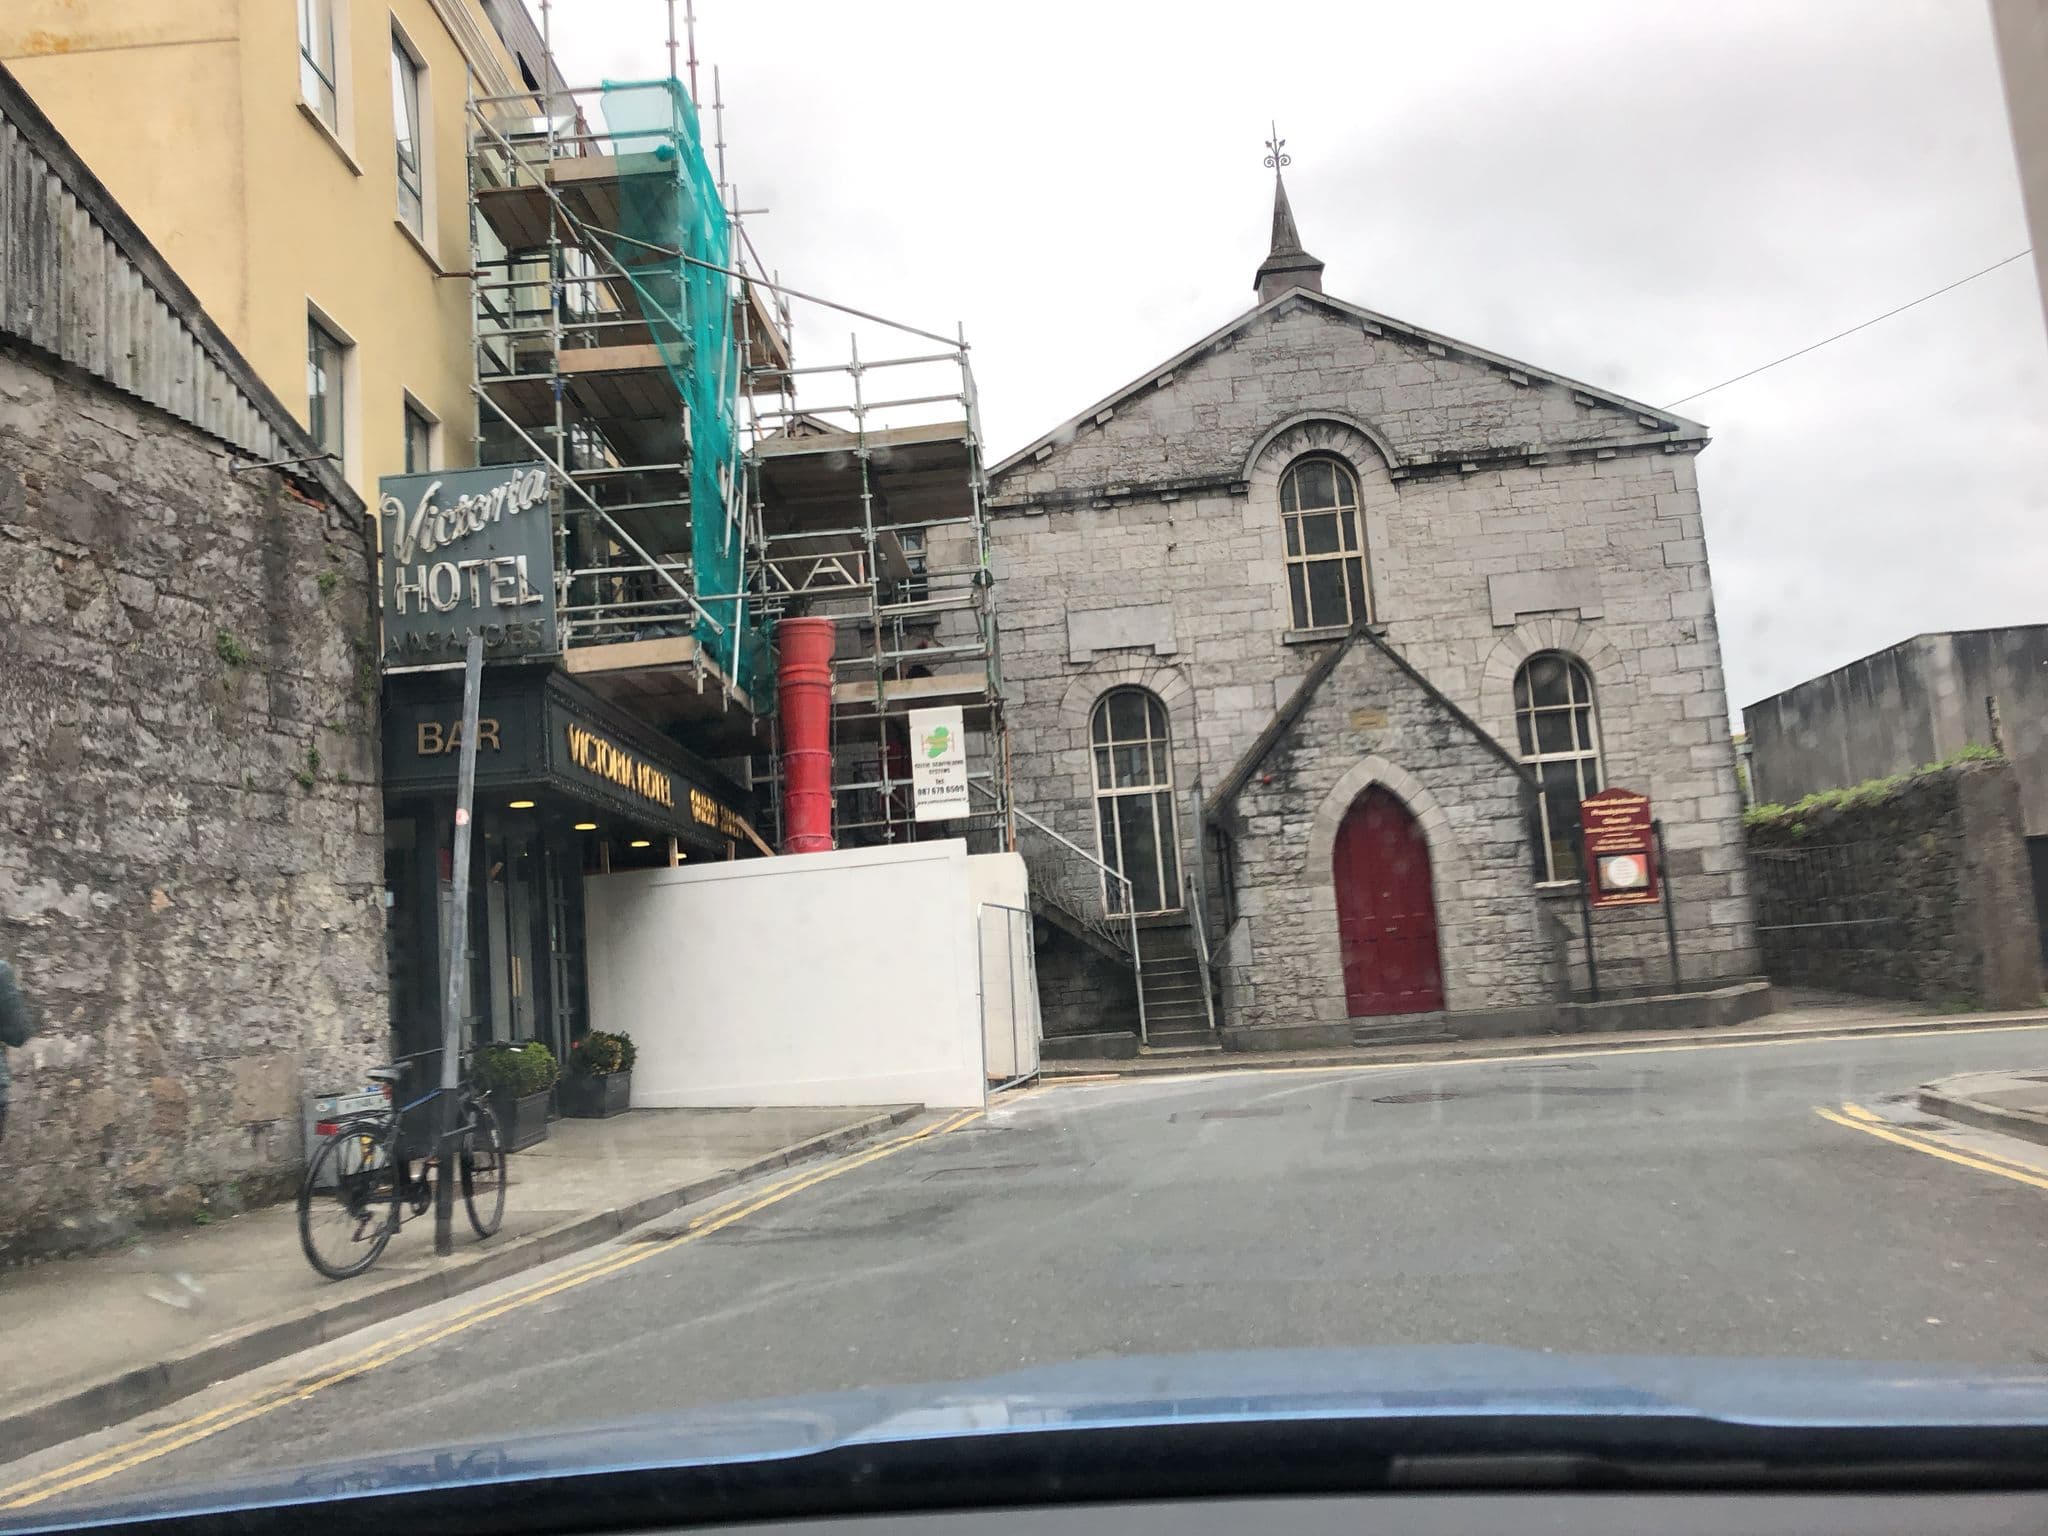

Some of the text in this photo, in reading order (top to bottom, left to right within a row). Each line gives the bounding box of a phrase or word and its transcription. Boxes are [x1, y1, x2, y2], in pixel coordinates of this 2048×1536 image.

[379, 468, 550, 565] Victoria
[395, 555, 544, 615] HOTEL
[417, 718, 500, 755] BAR
[568, 722, 636, 791] VICTORIA
[637, 761, 675, 809] HOTEL
